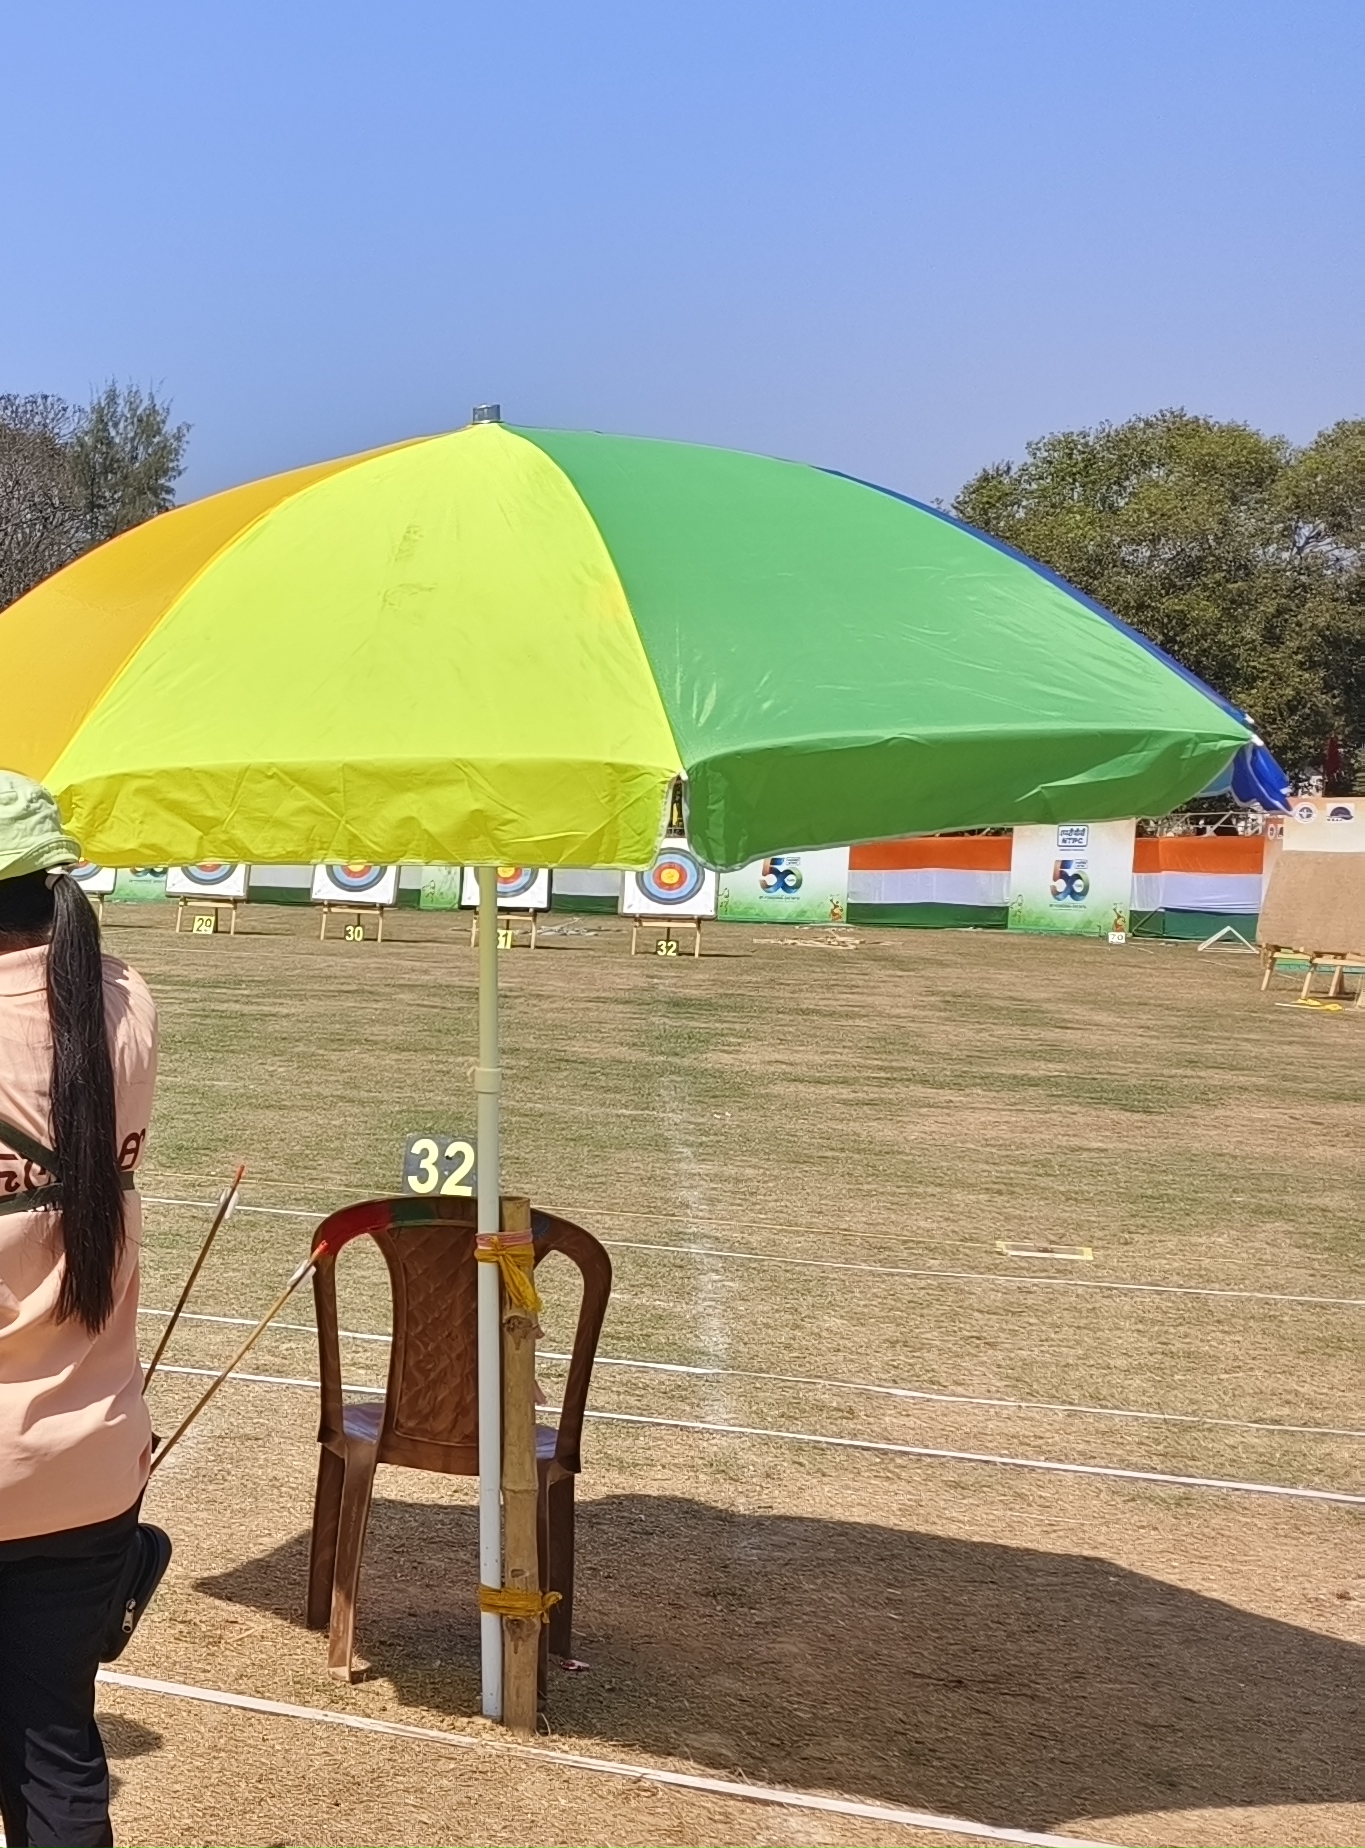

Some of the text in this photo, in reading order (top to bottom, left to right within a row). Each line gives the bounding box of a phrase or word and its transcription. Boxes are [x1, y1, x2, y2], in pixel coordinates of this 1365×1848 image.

[195, 917, 213, 933] 29
[345, 925, 364, 942] 30
[657, 940, 677, 956] 32
[407, 1138, 475, 1196] 32
